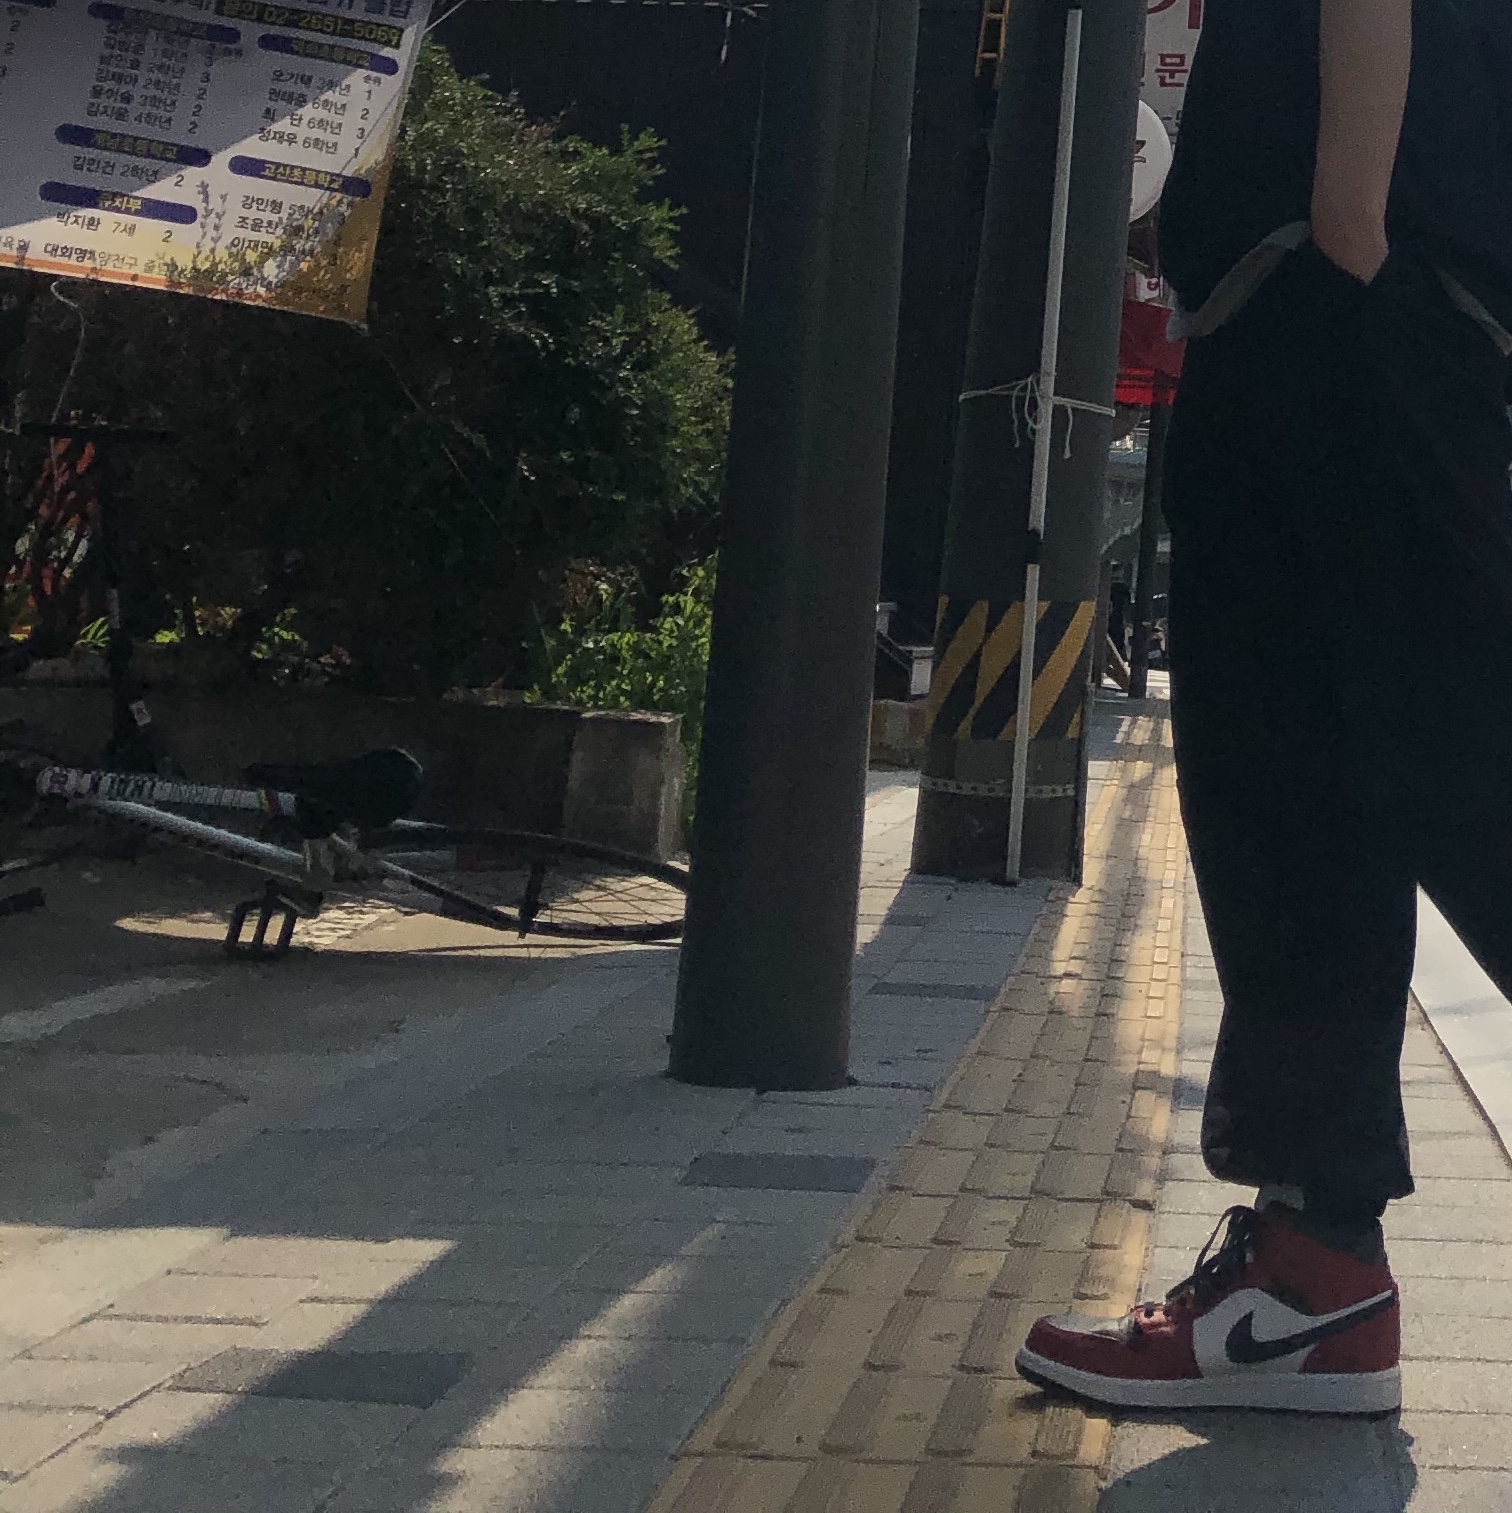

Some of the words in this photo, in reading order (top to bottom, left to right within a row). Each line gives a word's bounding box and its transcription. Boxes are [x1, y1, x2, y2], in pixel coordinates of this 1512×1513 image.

[196, 87, 208, 100] 2
[363, 89, 373, 101] 1
[139, 94, 177, 113] 3학년
[191, 104, 203, 117] 2
[312, 96, 346, 116] 6학년
[360, 108, 370, 121] 2
[134, 110, 173, 131] 4학년
[187, 121, 199, 135] 2
[307, 116, 343, 136] 6학년
[356, 128, 366, 140] 3
[302, 136, 339, 154] 6학년
[174, 174, 185, 188] 2
[240, 194, 284, 215] 강민형
[56, 212, 101, 232] 박지환
[112, 221, 137, 237] 7세
[162, 229, 173, 243] 2
